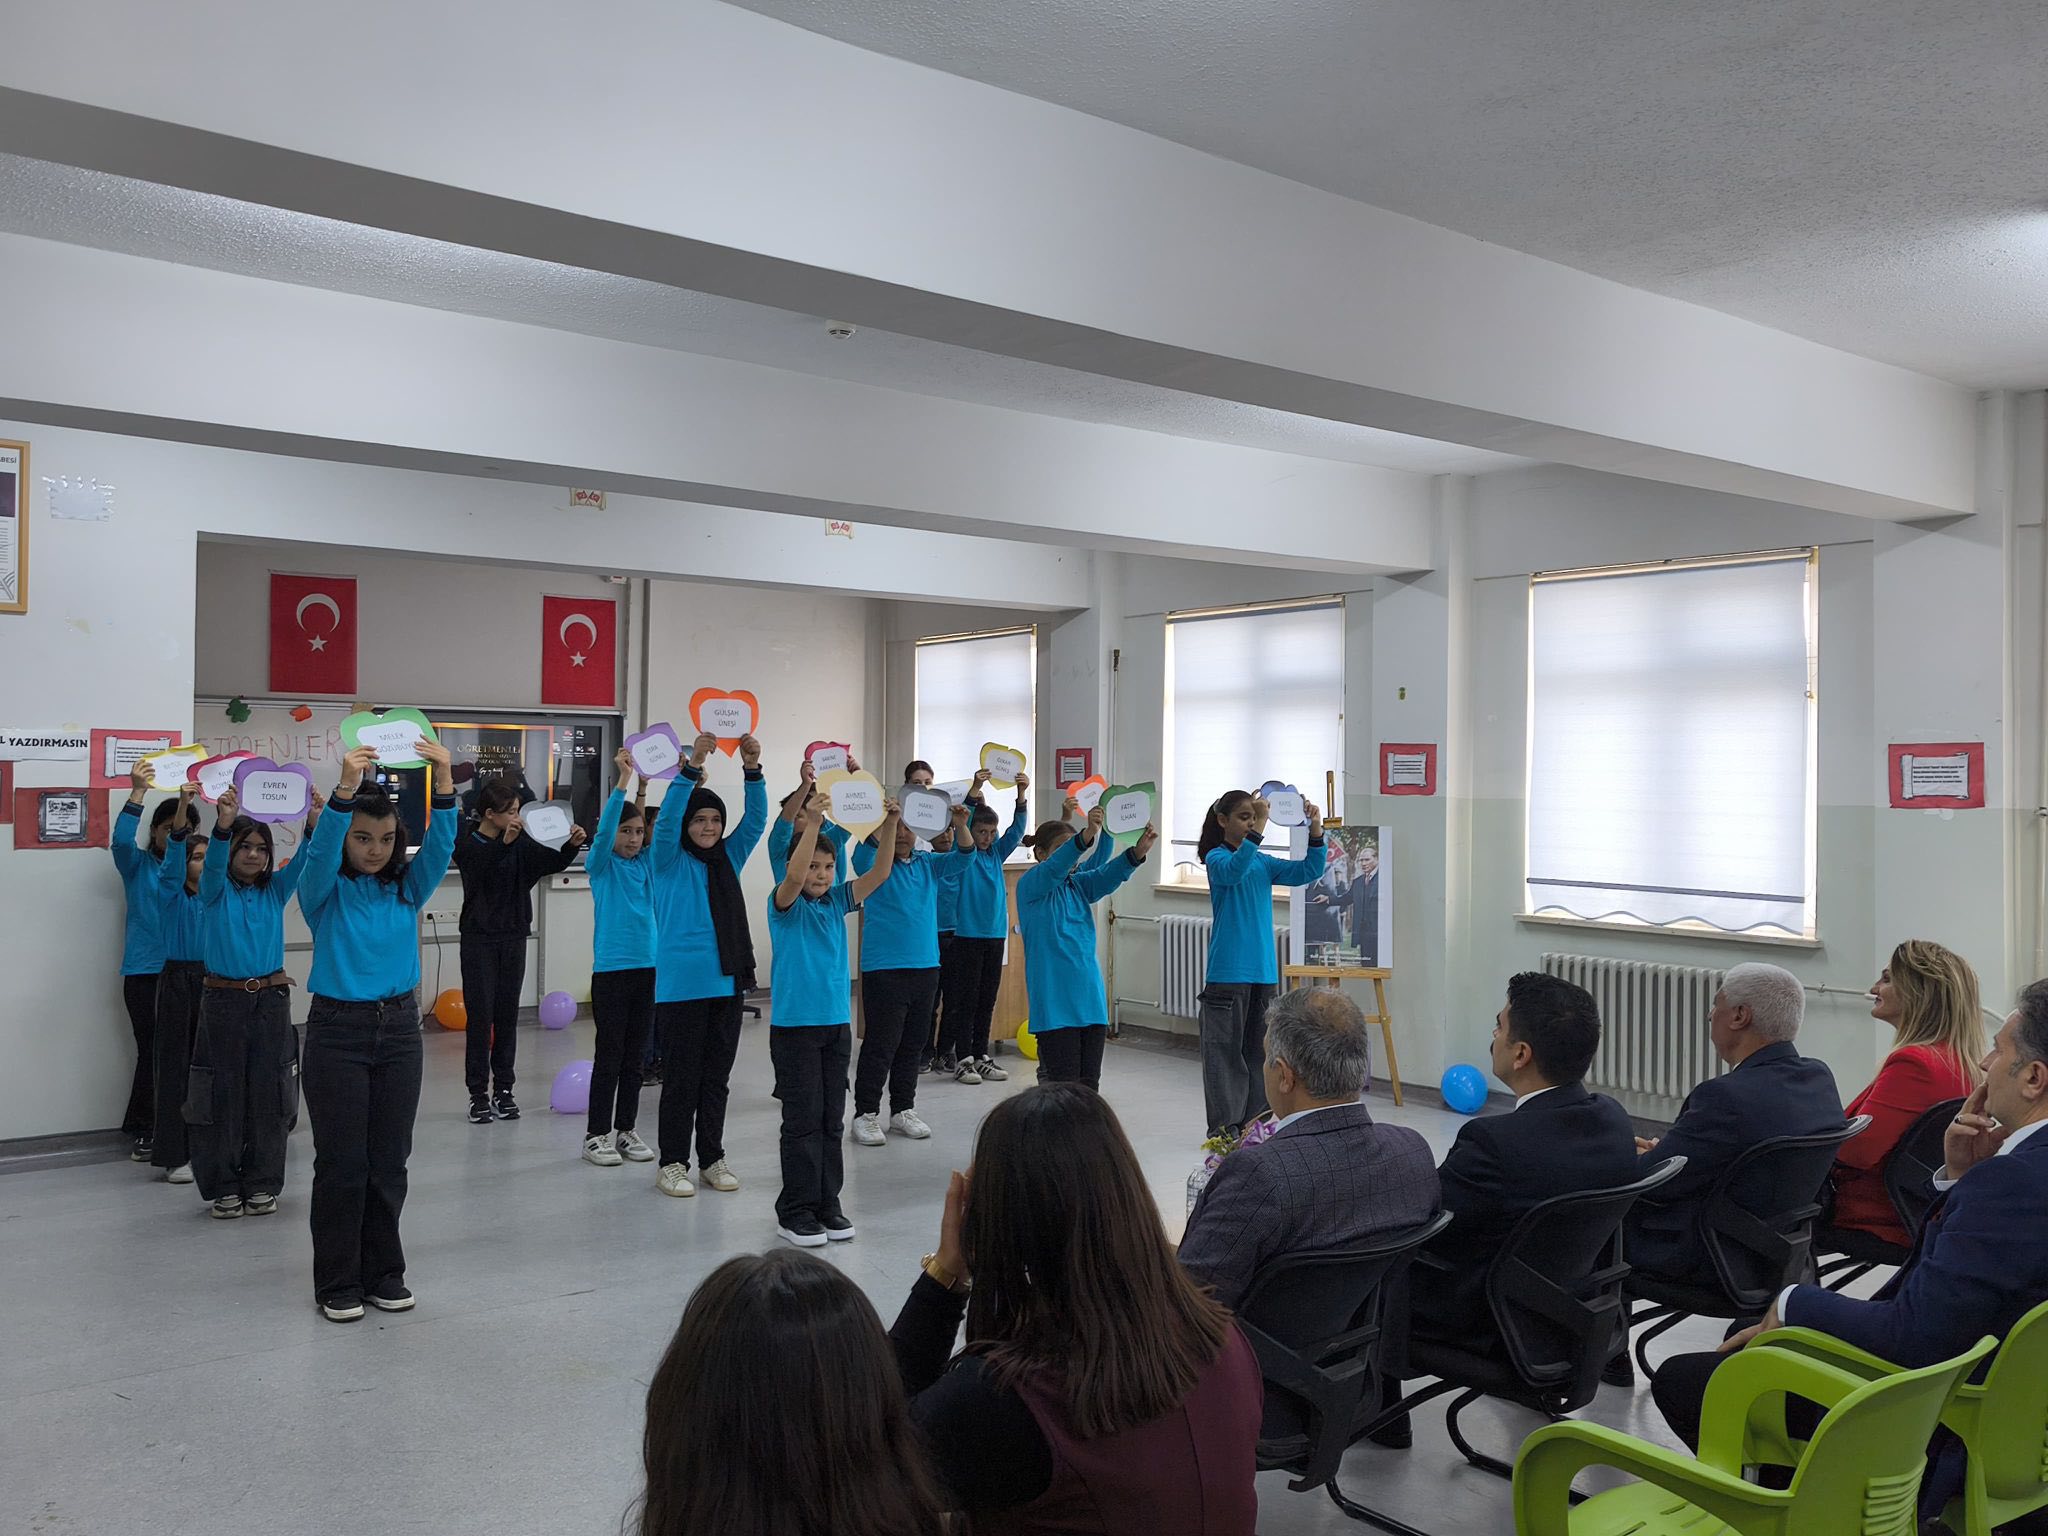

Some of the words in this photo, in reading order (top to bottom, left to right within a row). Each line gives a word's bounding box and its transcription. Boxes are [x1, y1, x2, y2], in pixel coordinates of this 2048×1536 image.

[9, 737, 88, 748] YAZDIRMASIN
[262, 781, 288, 790] EVREN
[261, 793, 288, 801] TOSUN
[845, 791, 867, 799] AHMET
